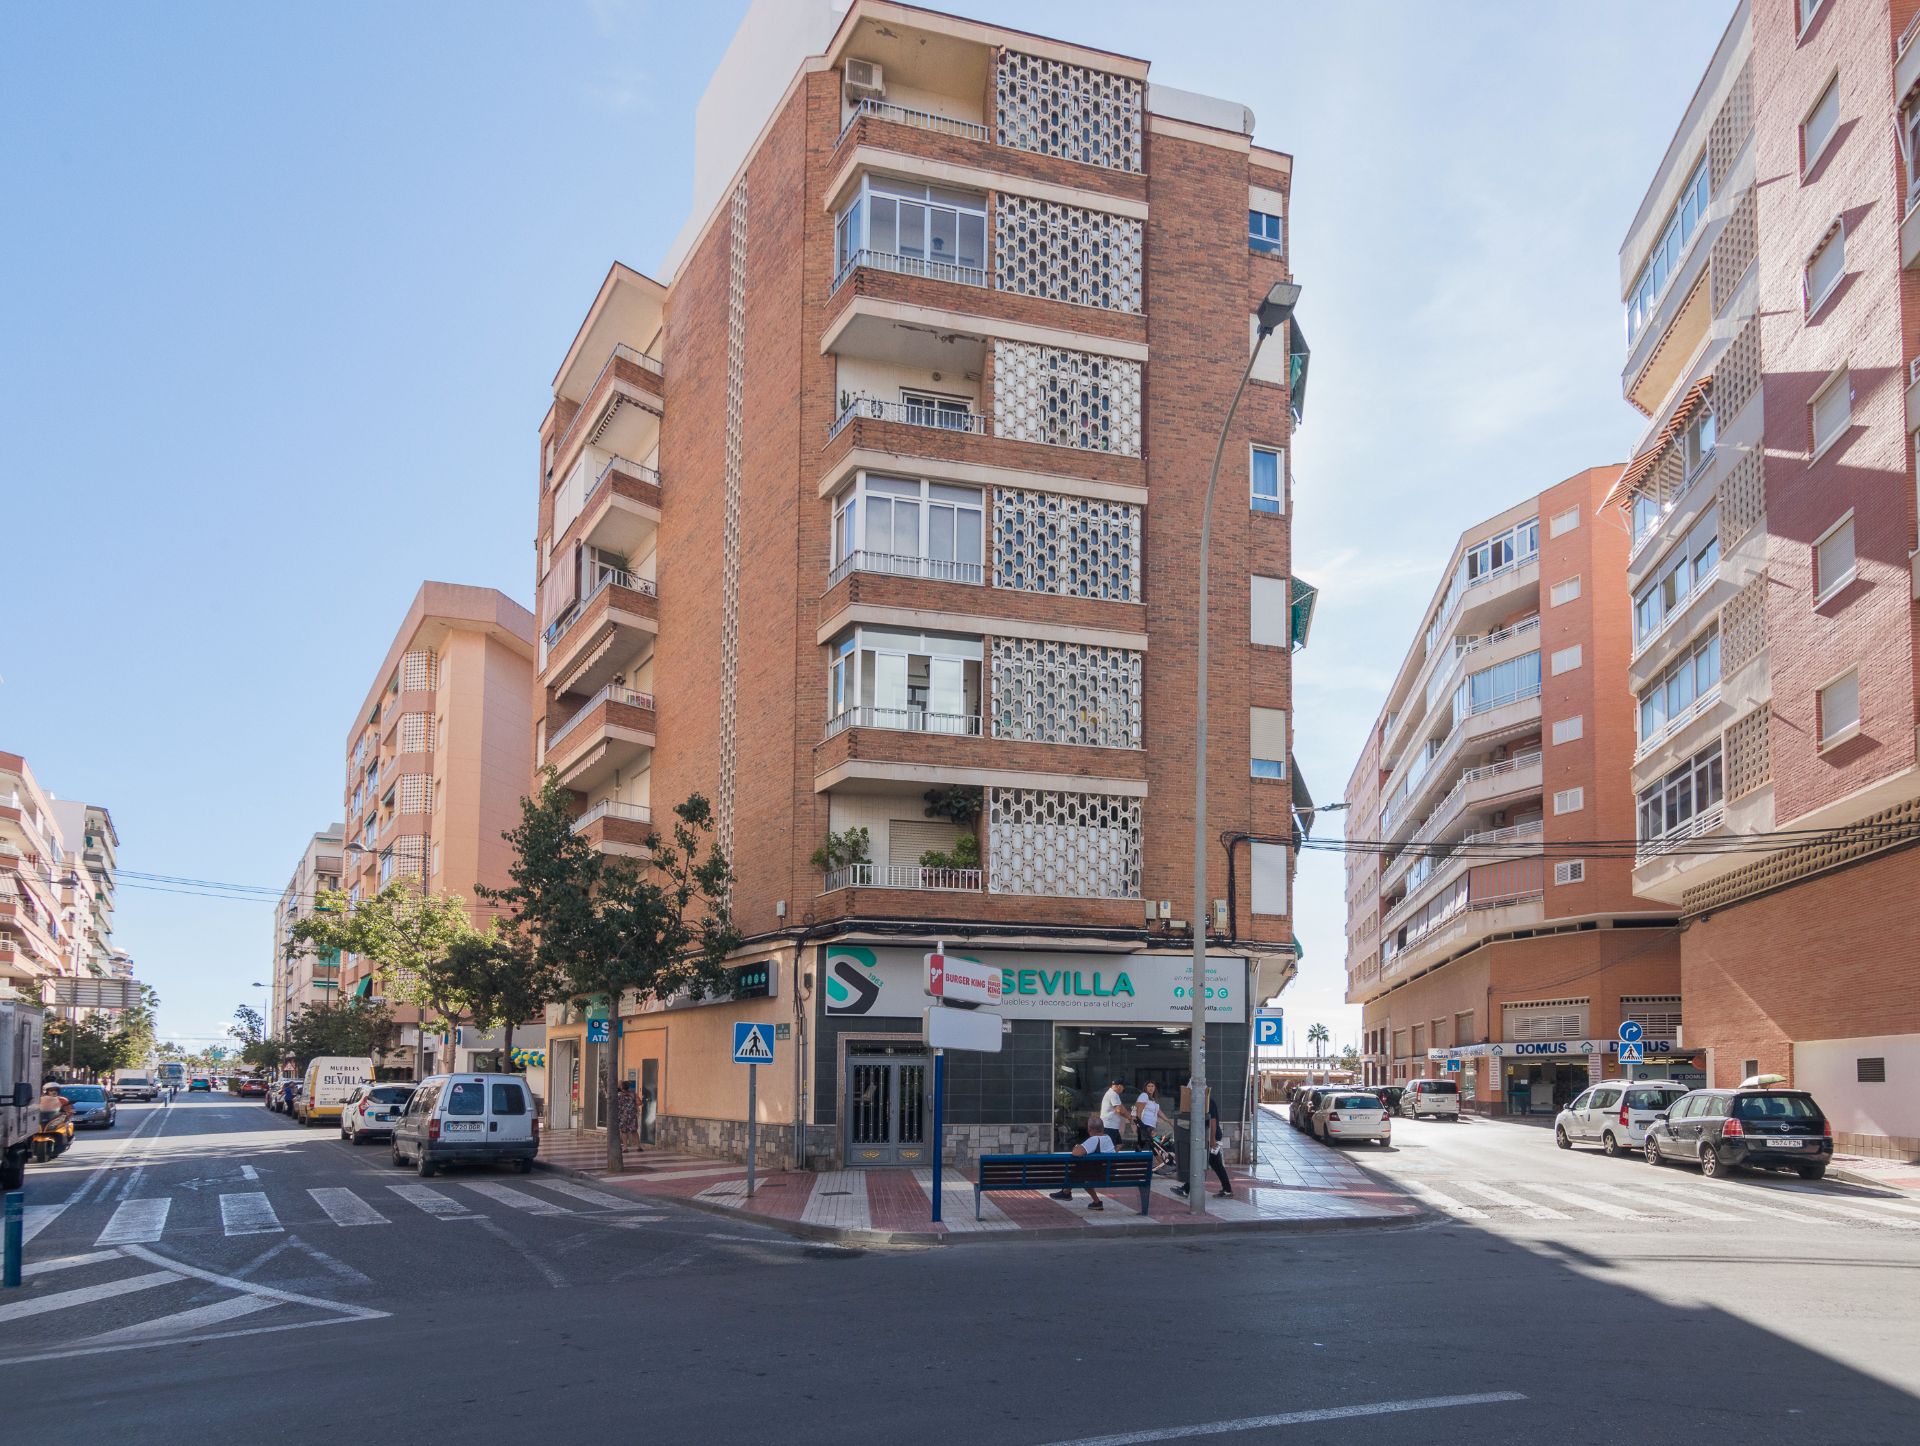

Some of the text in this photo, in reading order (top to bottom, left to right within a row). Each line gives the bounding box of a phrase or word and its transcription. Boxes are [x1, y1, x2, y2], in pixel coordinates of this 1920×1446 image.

[868, 973, 884, 987] 1963
[945, 973, 986, 989] BURGER KING
[1001, 968, 1135, 997] SEVILLA
[987, 986, 1001, 995] KING
[1039, 999, 1081, 1007] decoración
[1103, 1000, 1110, 1008] el
[1111, 1000, 1135, 1009] hogar
[1260, 1021, 1277, 1042] P
[592, 1034, 609, 1042] ATM
[1515, 1042, 1567, 1055] DOMUS
[1609, 1040, 1670, 1052] DUS
[324, 1075, 364, 1085] SEVILLA
